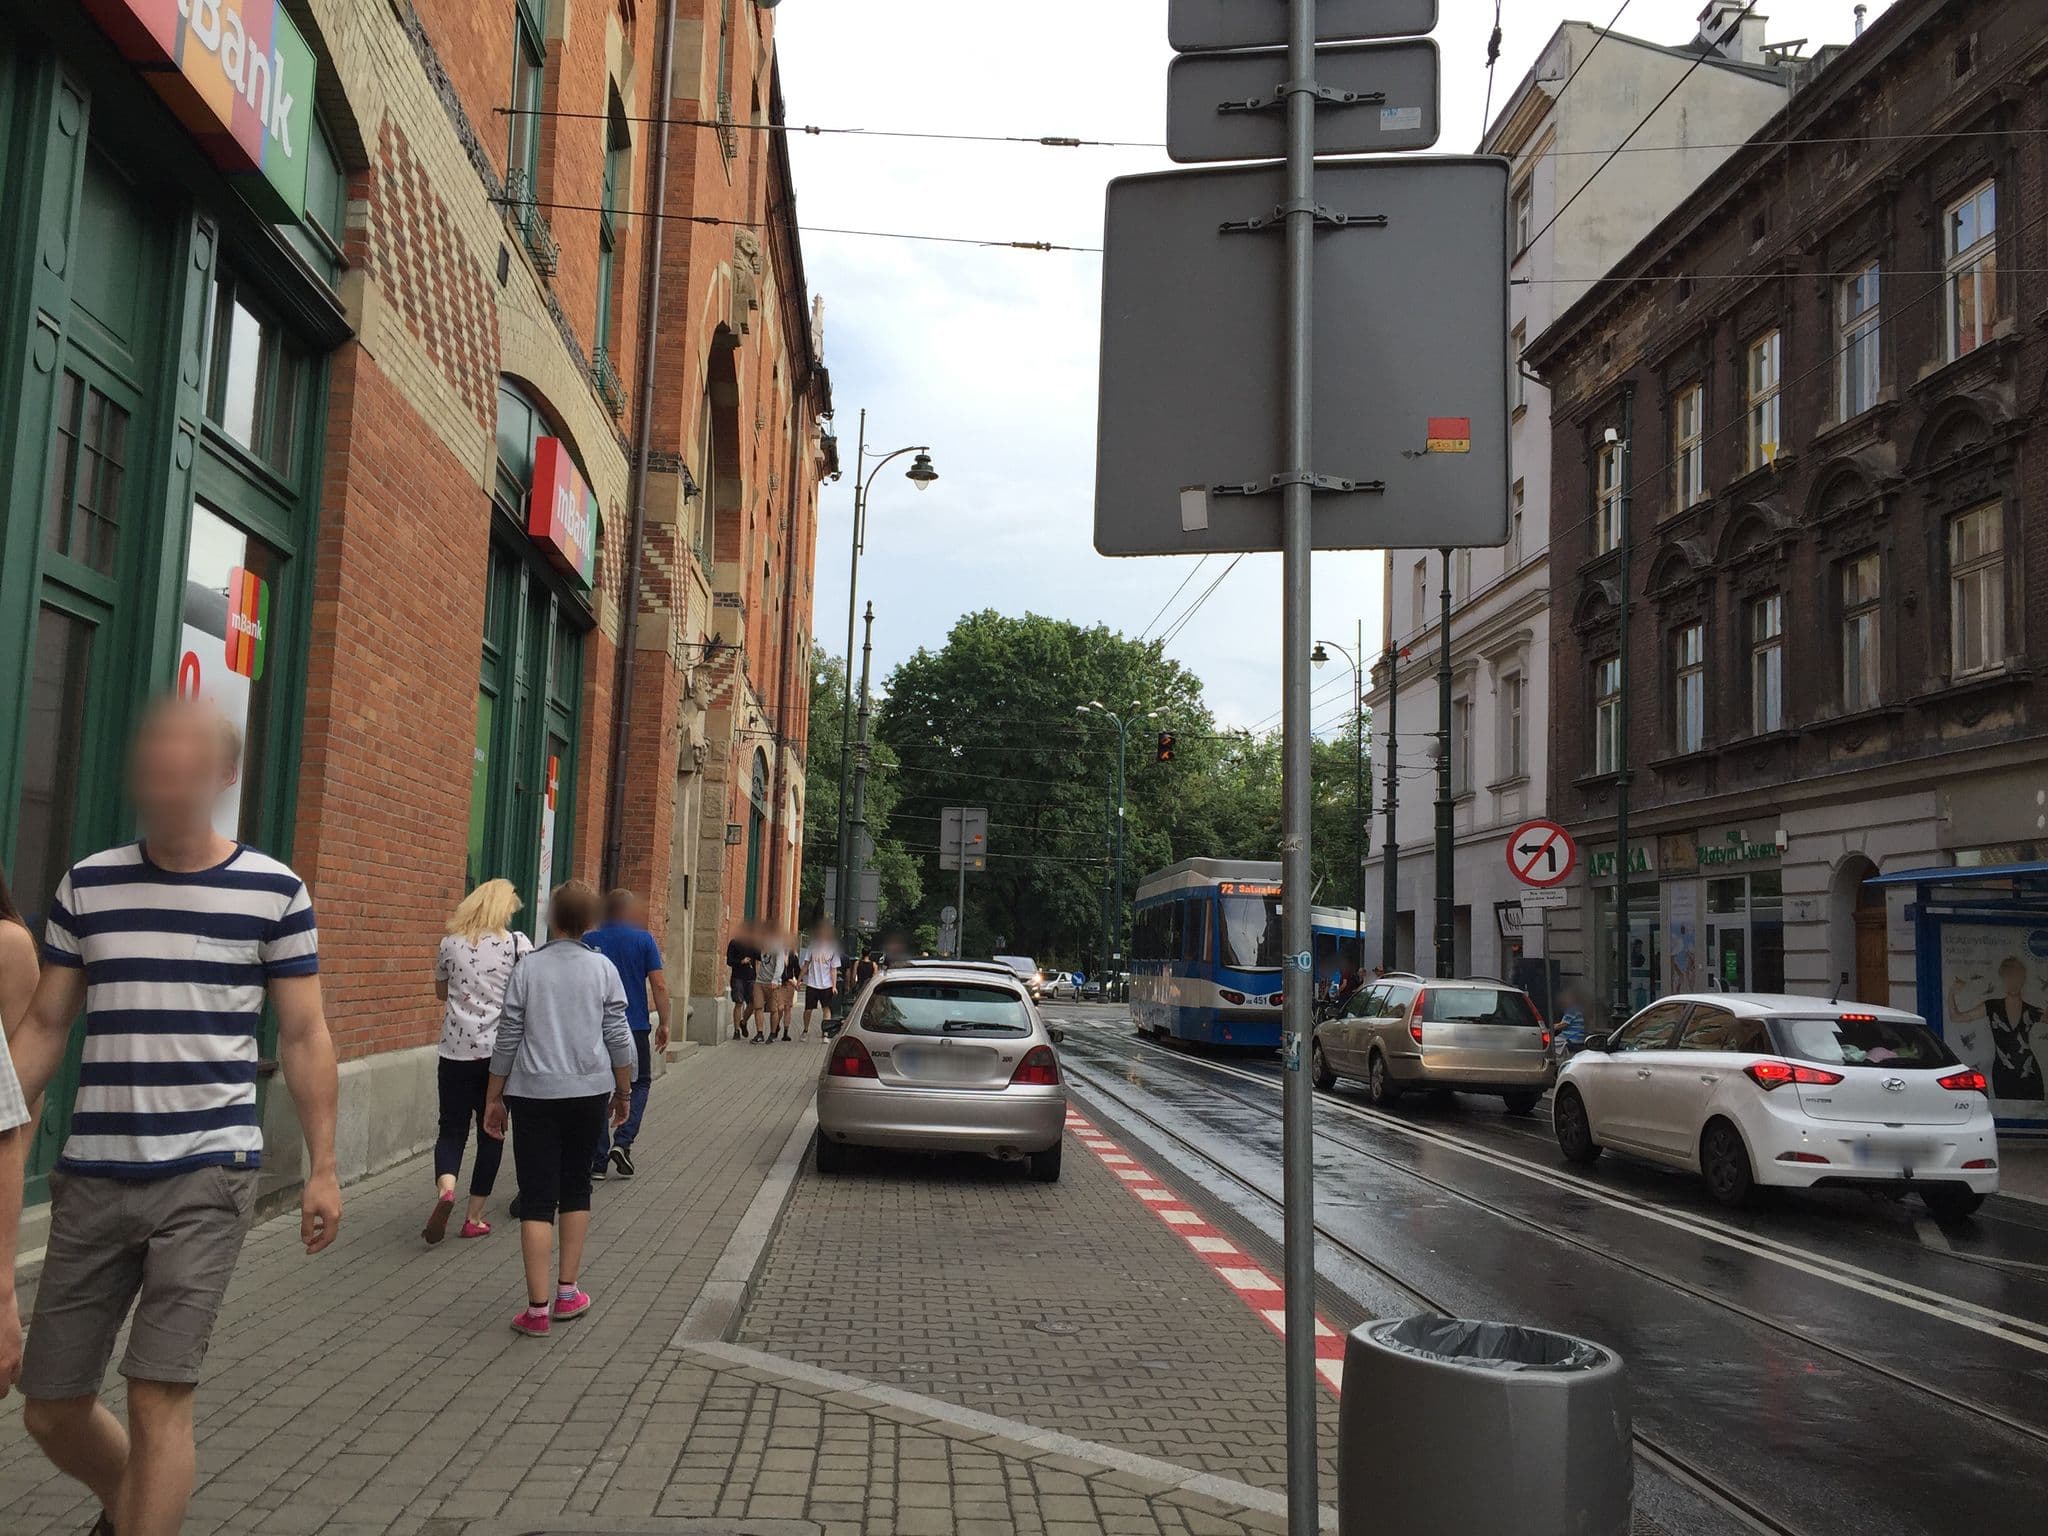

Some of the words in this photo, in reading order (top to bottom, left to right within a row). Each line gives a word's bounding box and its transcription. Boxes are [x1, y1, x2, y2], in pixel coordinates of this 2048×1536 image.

[178, 0, 293, 158] Bank
[557, 484, 591, 560] mBank
[231, 612, 262, 640] mBank
[1221, 883, 1233, 894] 72
[1253, 996, 1267, 1005] 451
